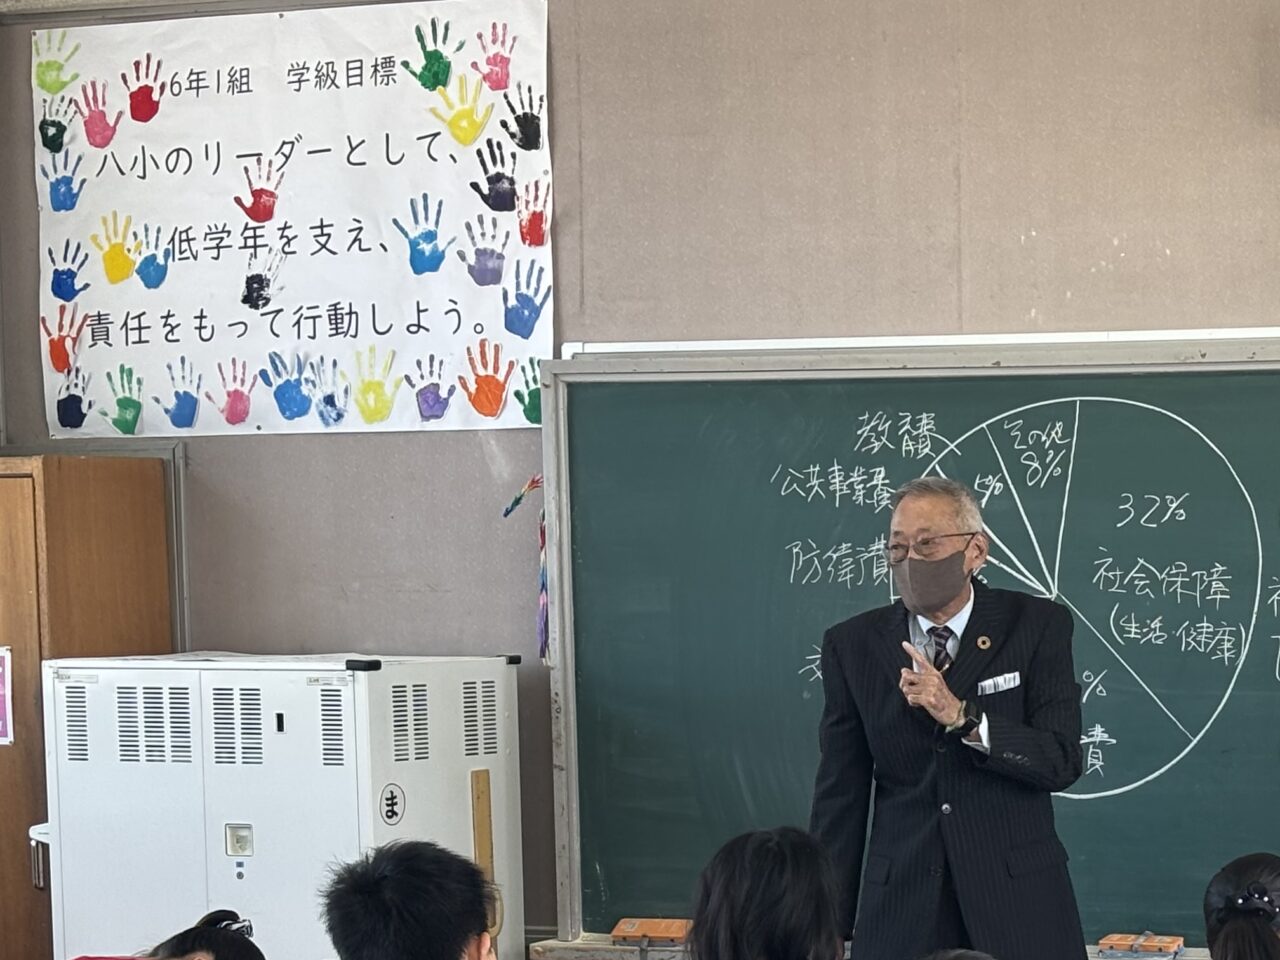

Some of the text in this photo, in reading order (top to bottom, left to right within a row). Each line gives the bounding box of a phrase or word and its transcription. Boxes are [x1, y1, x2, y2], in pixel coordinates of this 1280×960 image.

[286, 56, 399, 92] 学級目標
[95, 131, 460, 180] 八小のリーダーとして、
[168, 220, 390, 261] 低学年を支え、
[87, 299, 491, 349] 責任をもって行動しよう。
[1019, 449, 1066, 489] 8%
[1116, 492, 1190, 528] 32%
[1092, 546, 1232, 611] 社会保障
